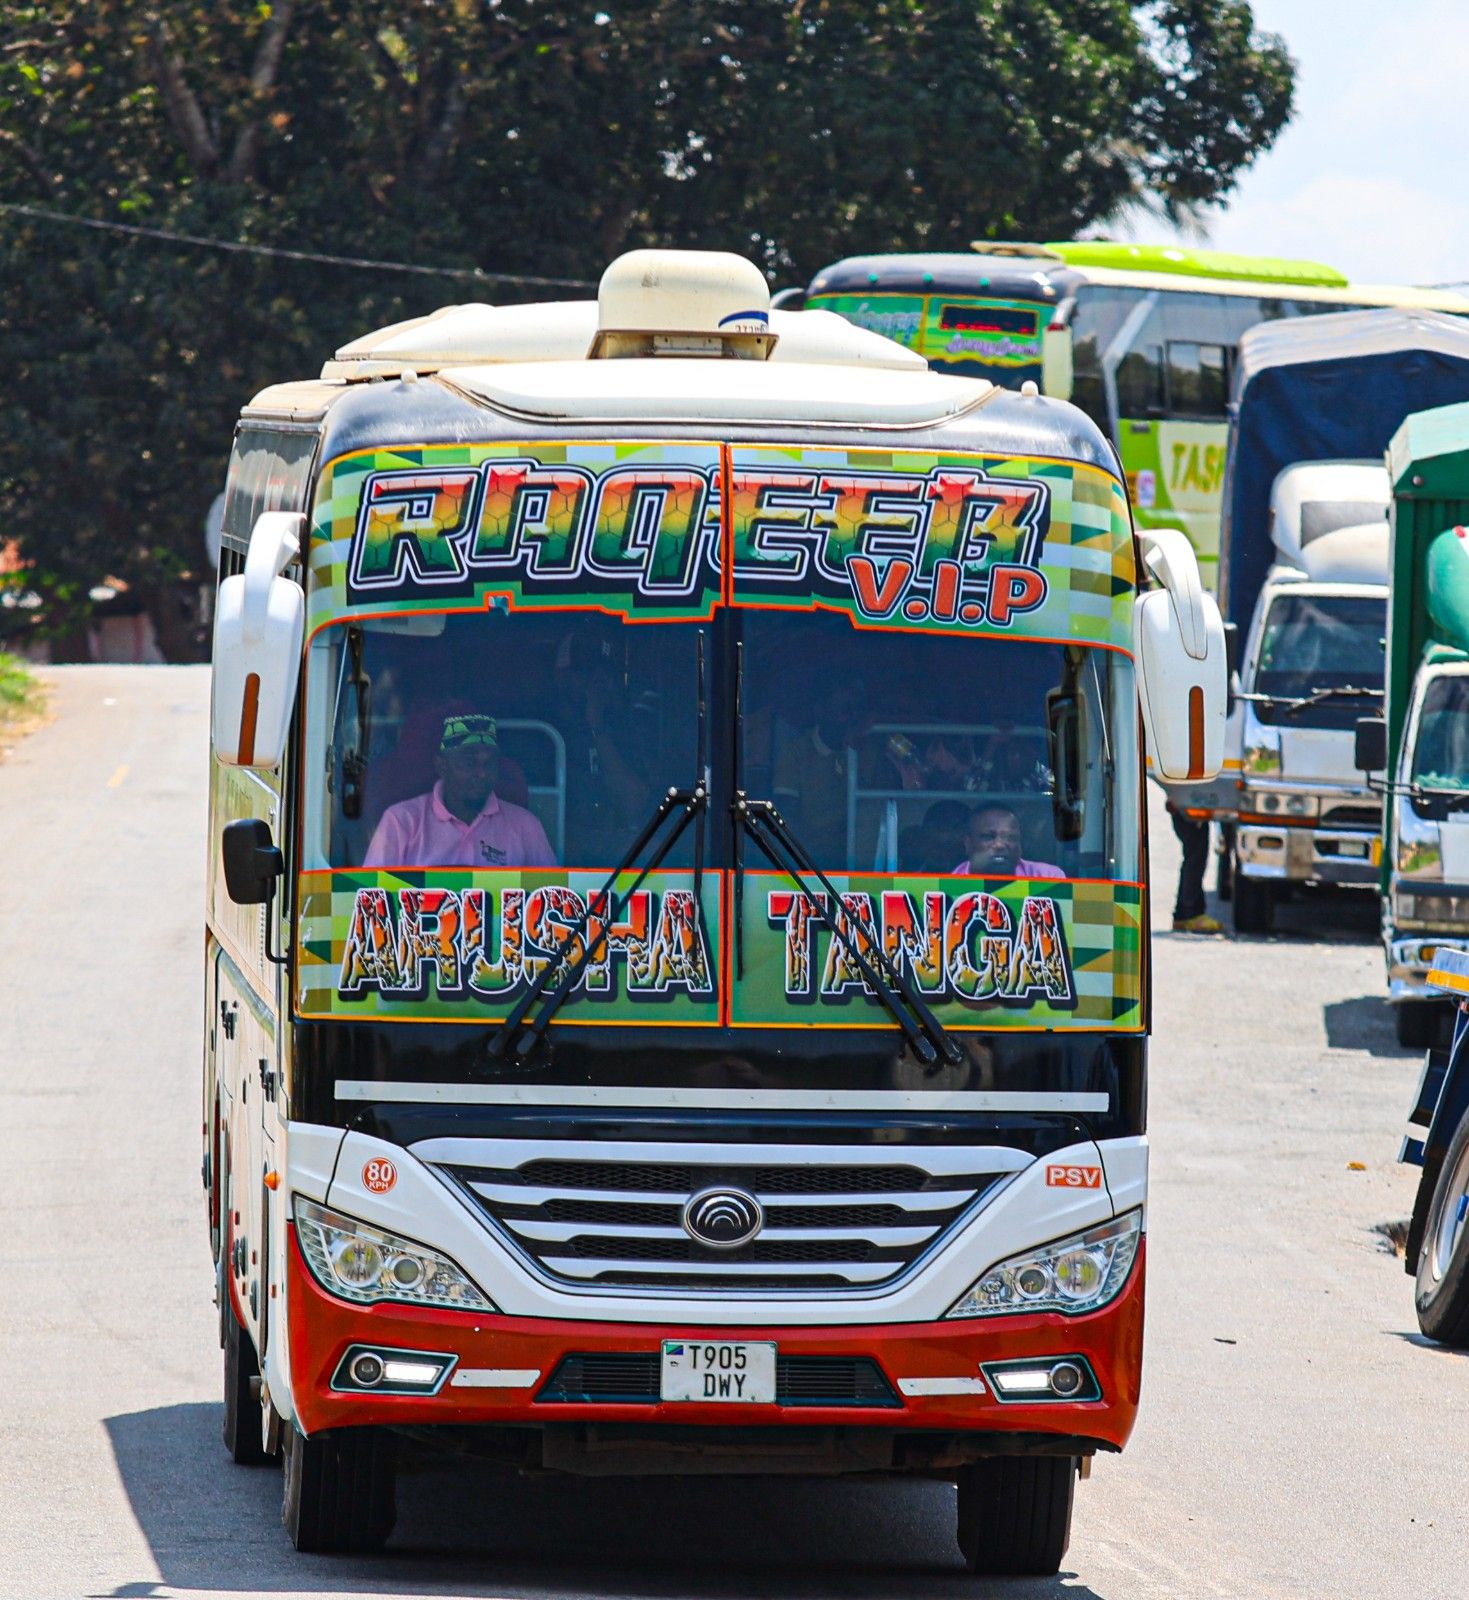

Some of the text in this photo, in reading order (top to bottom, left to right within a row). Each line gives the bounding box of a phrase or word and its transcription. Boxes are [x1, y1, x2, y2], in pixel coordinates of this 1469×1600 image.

[349, 457, 1049, 597] RAQEEB
[845, 555, 1048, 626] V.I.P
[338, 886, 1072, 1001] ARUSHA TANGA
[367, 1162, 393, 1182] 80
[1049, 1167, 1099, 1187] PSV
[368, 1181, 390, 1190] KPH
[688, 1345, 747, 1370] T905
[703, 1373, 747, 1398] DWY
